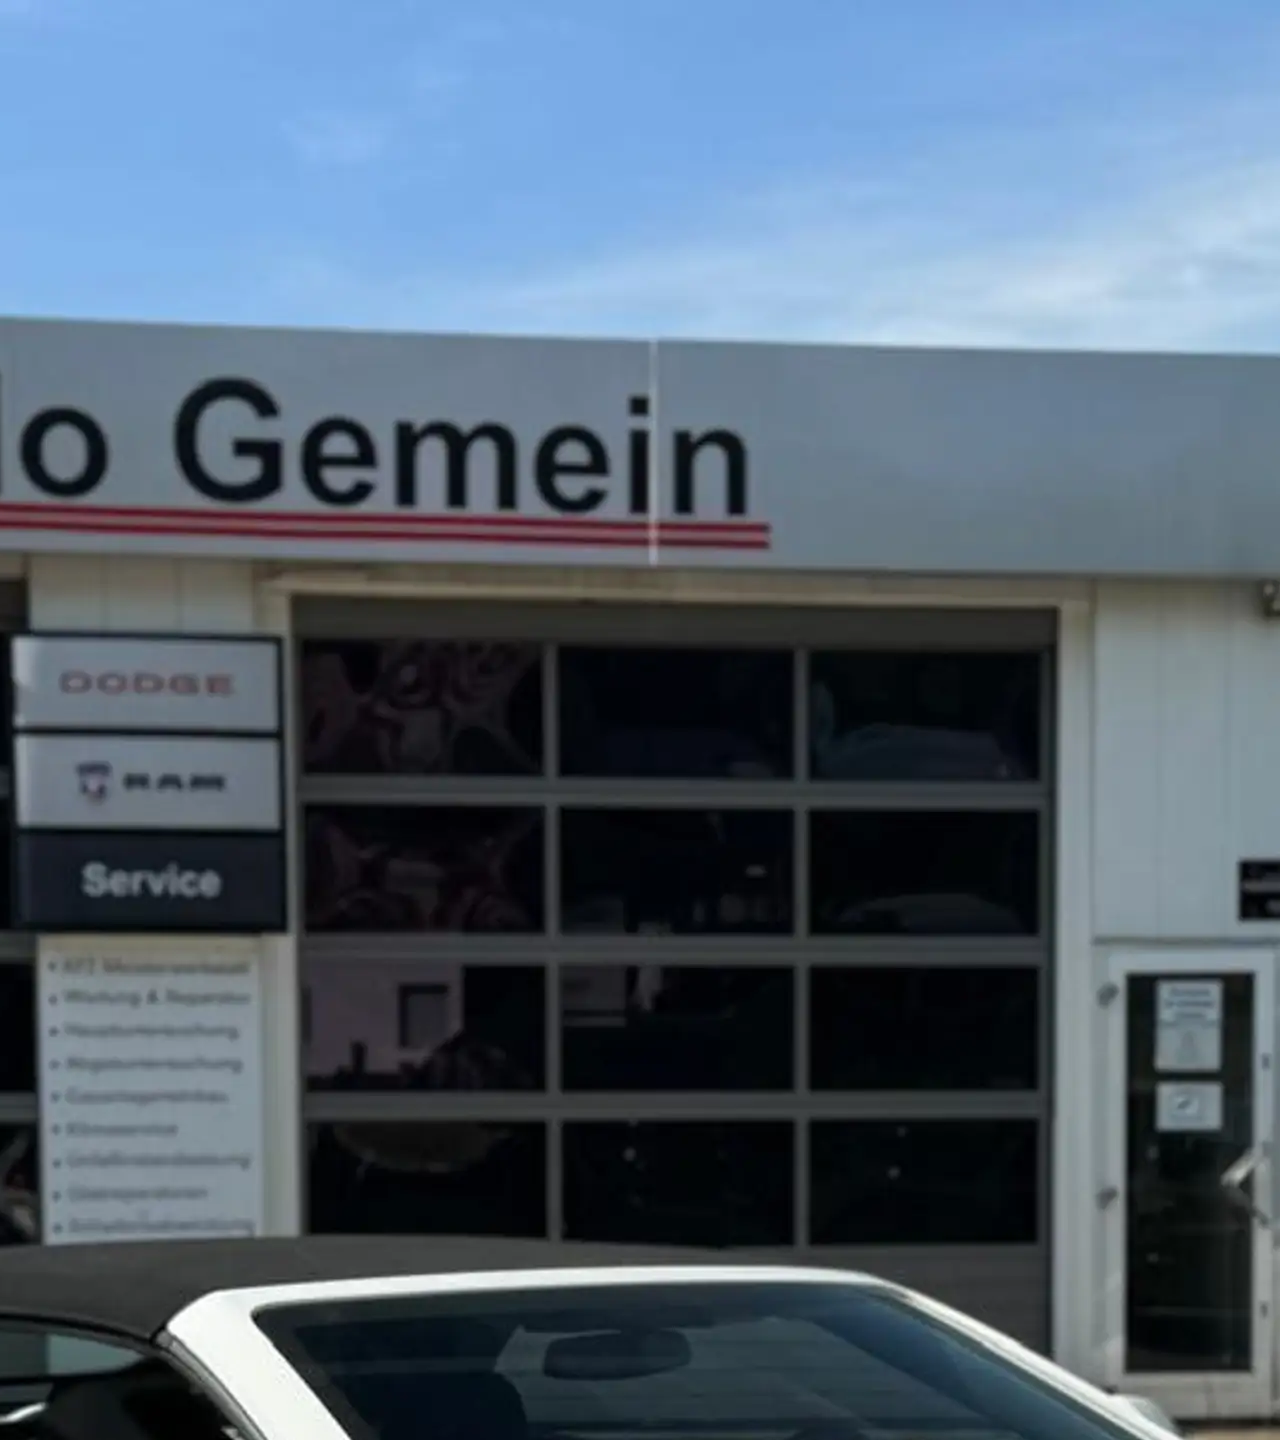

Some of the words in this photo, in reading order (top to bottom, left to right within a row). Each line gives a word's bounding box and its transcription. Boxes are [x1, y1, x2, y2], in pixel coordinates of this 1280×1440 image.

[171, 376, 749, 517] Gemein
[58, 671, 236, 696] DODGE
[122, 771, 226, 793] RAM
[81, 861, 223, 898] Service
